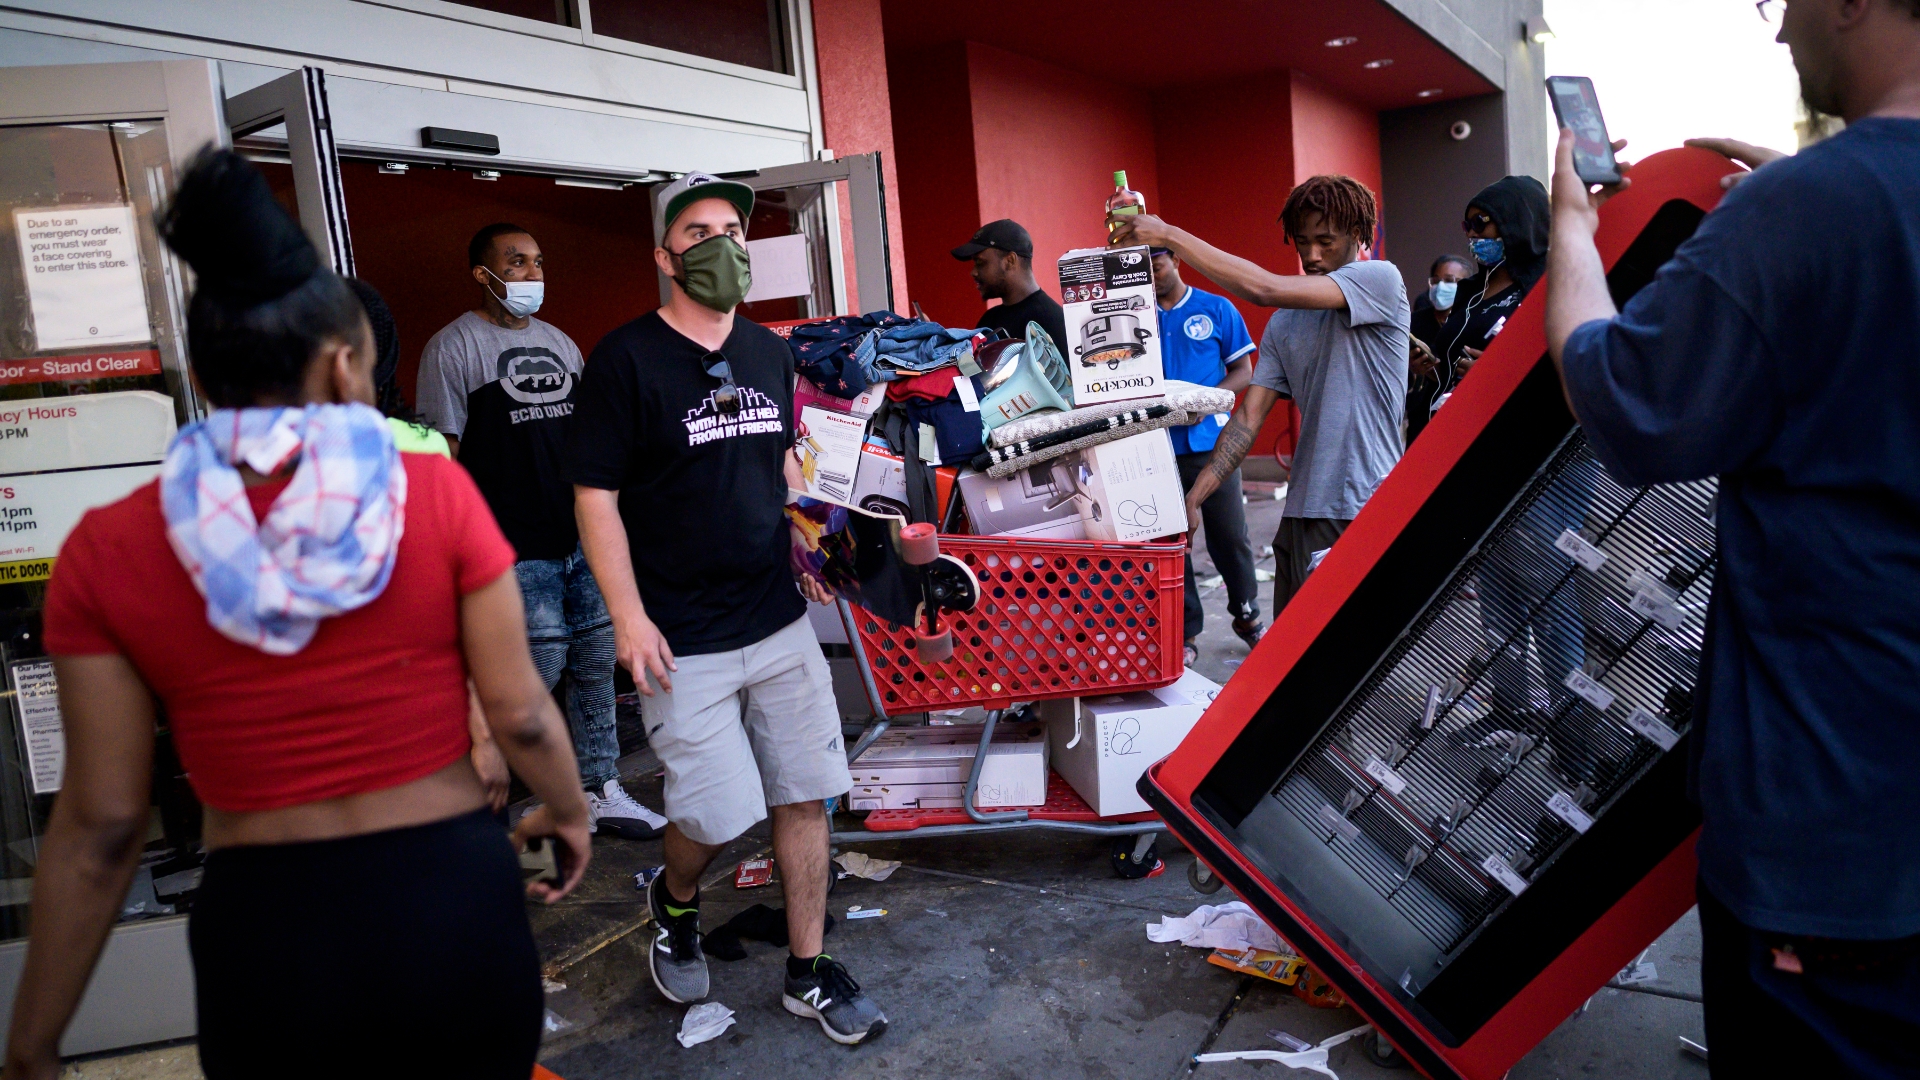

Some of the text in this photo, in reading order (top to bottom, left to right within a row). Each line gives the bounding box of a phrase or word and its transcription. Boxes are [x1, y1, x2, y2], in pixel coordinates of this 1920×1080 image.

[27, 218, 78, 228] Due to an
[29, 226, 122, 240] emergency order,
[31, 238, 108, 253] you must wear
[33, 249, 112, 262] a face covering
[34, 259, 129, 273] to enter this store.
[43, 358, 92, 375] Stand
[96, 357, 141, 371] Clear
[28, 406, 77, 420] Hours
[686, 415, 717, 434] WITH
[718, 413, 728, 426] A
[756, 407, 780, 419] HELP
[826, 415, 862, 427] KitchenAid
[688, 427, 724, 447] FROM
[739, 420, 783, 436] FRIENDS
[0, 520, 37, 533] 11pm
[1124, 526, 1163, 539] PROJECT
[19, 563, 50, 578] DOOR
[25, 706, 56, 714] Effective
[1102, 719, 1110, 758] PROJECT
